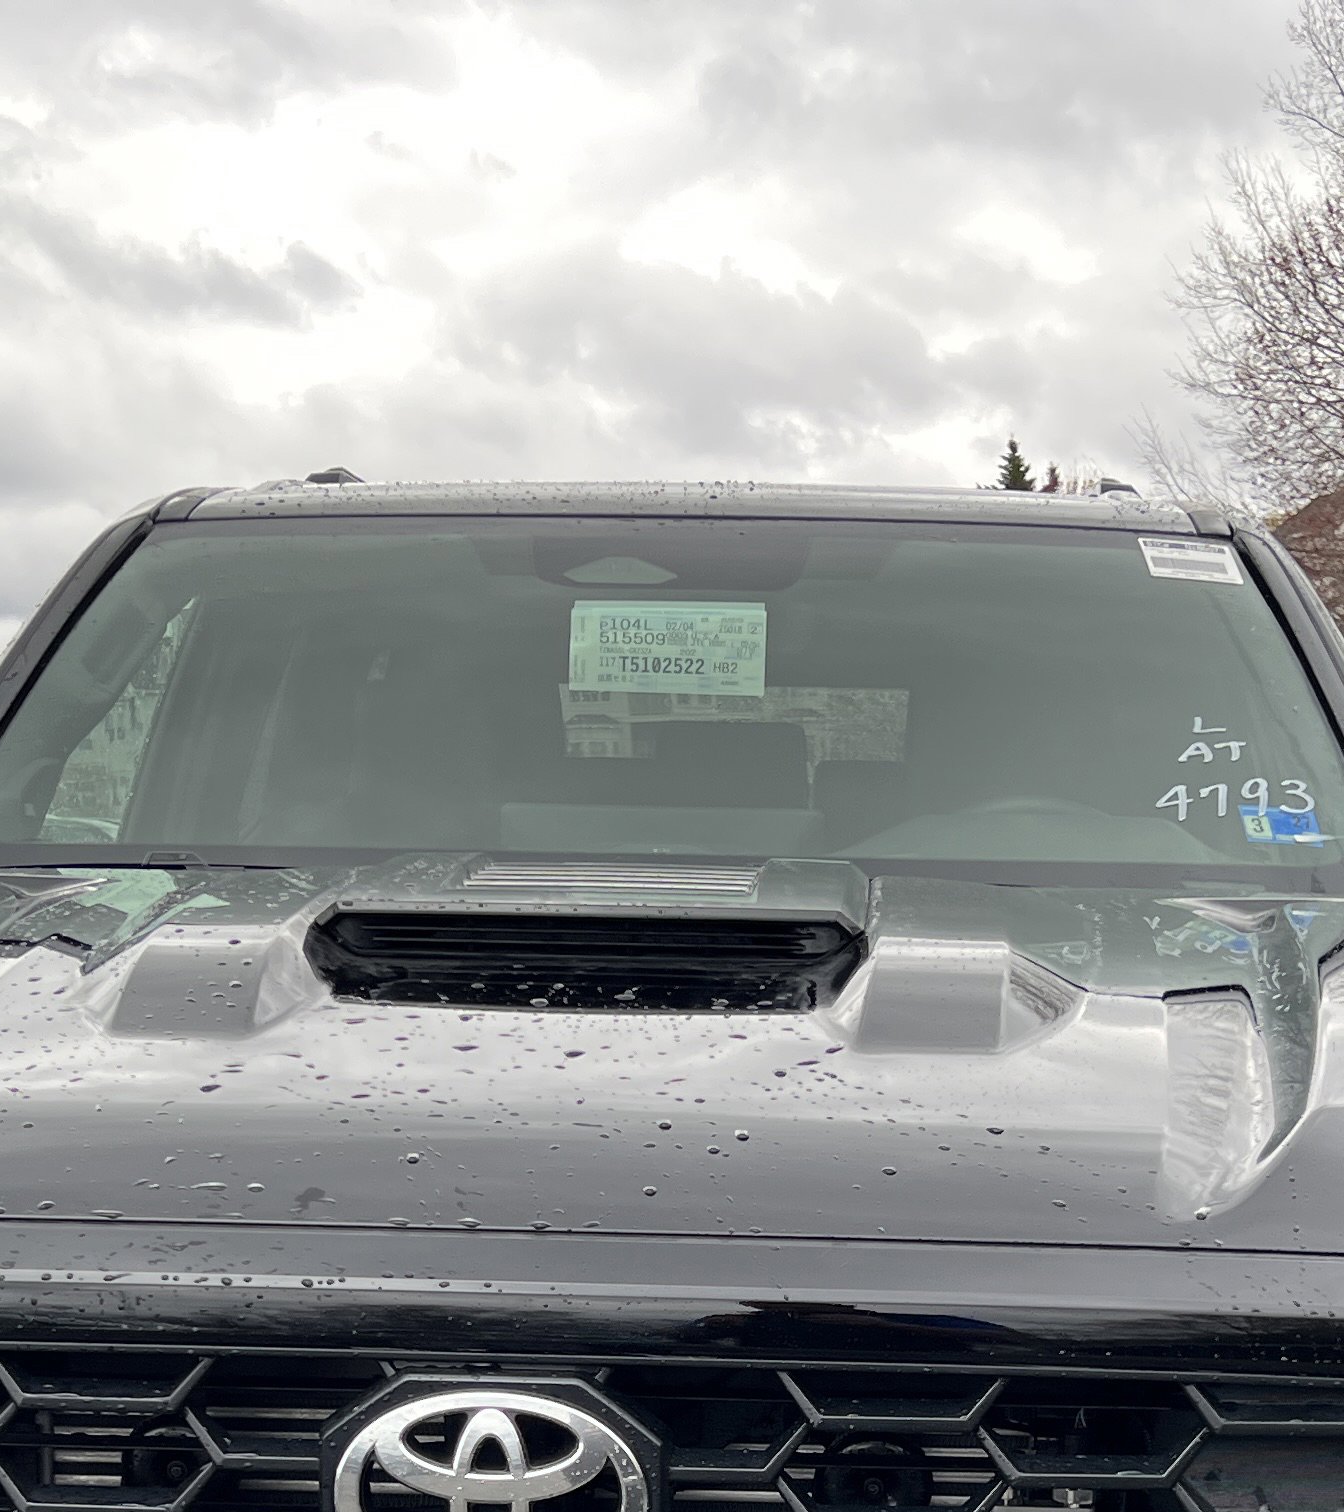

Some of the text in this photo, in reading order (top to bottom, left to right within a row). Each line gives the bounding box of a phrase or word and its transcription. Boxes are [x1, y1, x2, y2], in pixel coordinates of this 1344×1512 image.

[599, 631, 666, 646] 515509
[619, 656, 705, 674] T5102522
[1192, 716, 1227, 734] L
[1177, 741, 1247, 763] AT
[1155, 777, 1316, 822] 4793
[1251, 817, 1264, 833] 3
